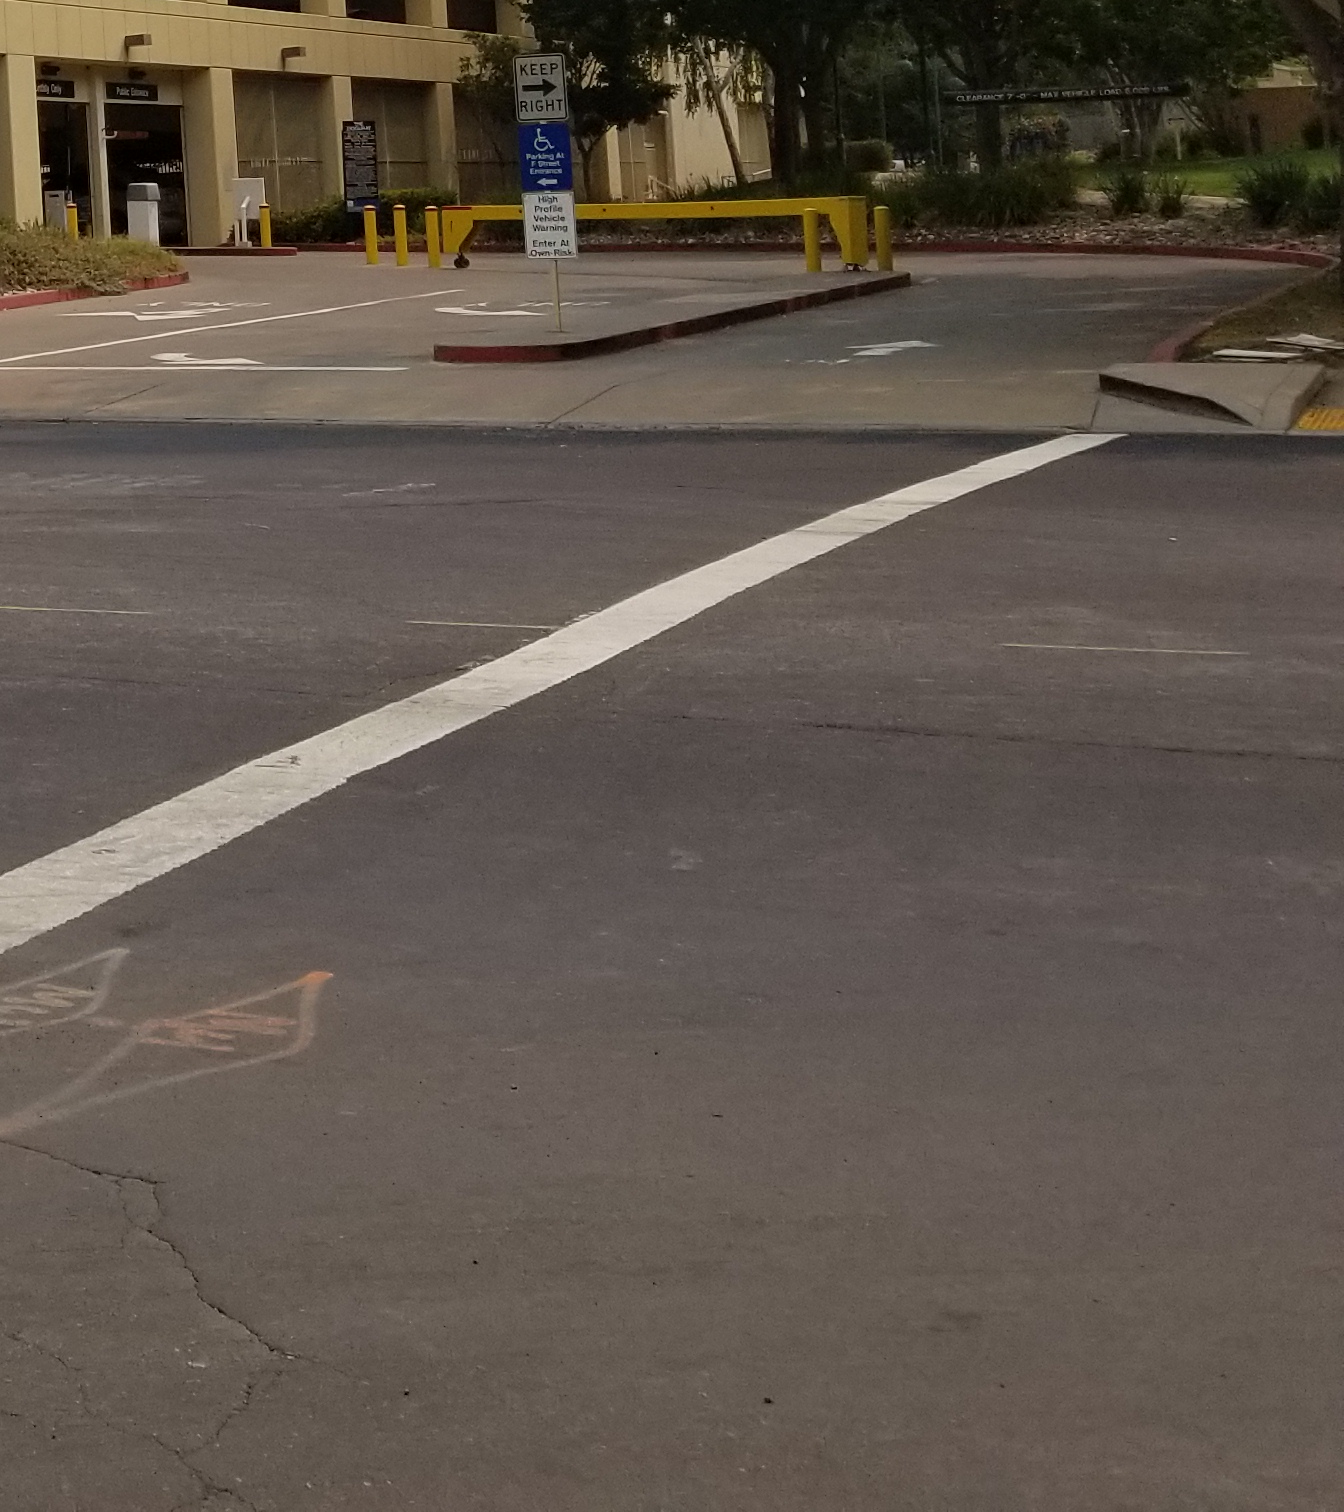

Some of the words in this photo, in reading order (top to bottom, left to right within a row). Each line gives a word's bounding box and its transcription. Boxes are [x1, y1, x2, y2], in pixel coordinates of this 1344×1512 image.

[519, 62, 559, 76] KEEP
[956, 93, 1005, 102] CLEARANCE
[1040, 91, 1059, 99] MAX
[1061, 90, 1097, 98] VEHICLE
[1099, 88, 1122, 96] LOAD
[519, 99, 564, 113] RIGHT
[525, 152, 555, 161] Parking
[537, 160, 561, 168] Street
[537, 195, 559, 204] High
[534, 205, 564, 213] Profile
[533, 214, 566, 223] Vehicle
[532, 224, 568, 233] Warning
[532, 239, 557, 248] Enter
